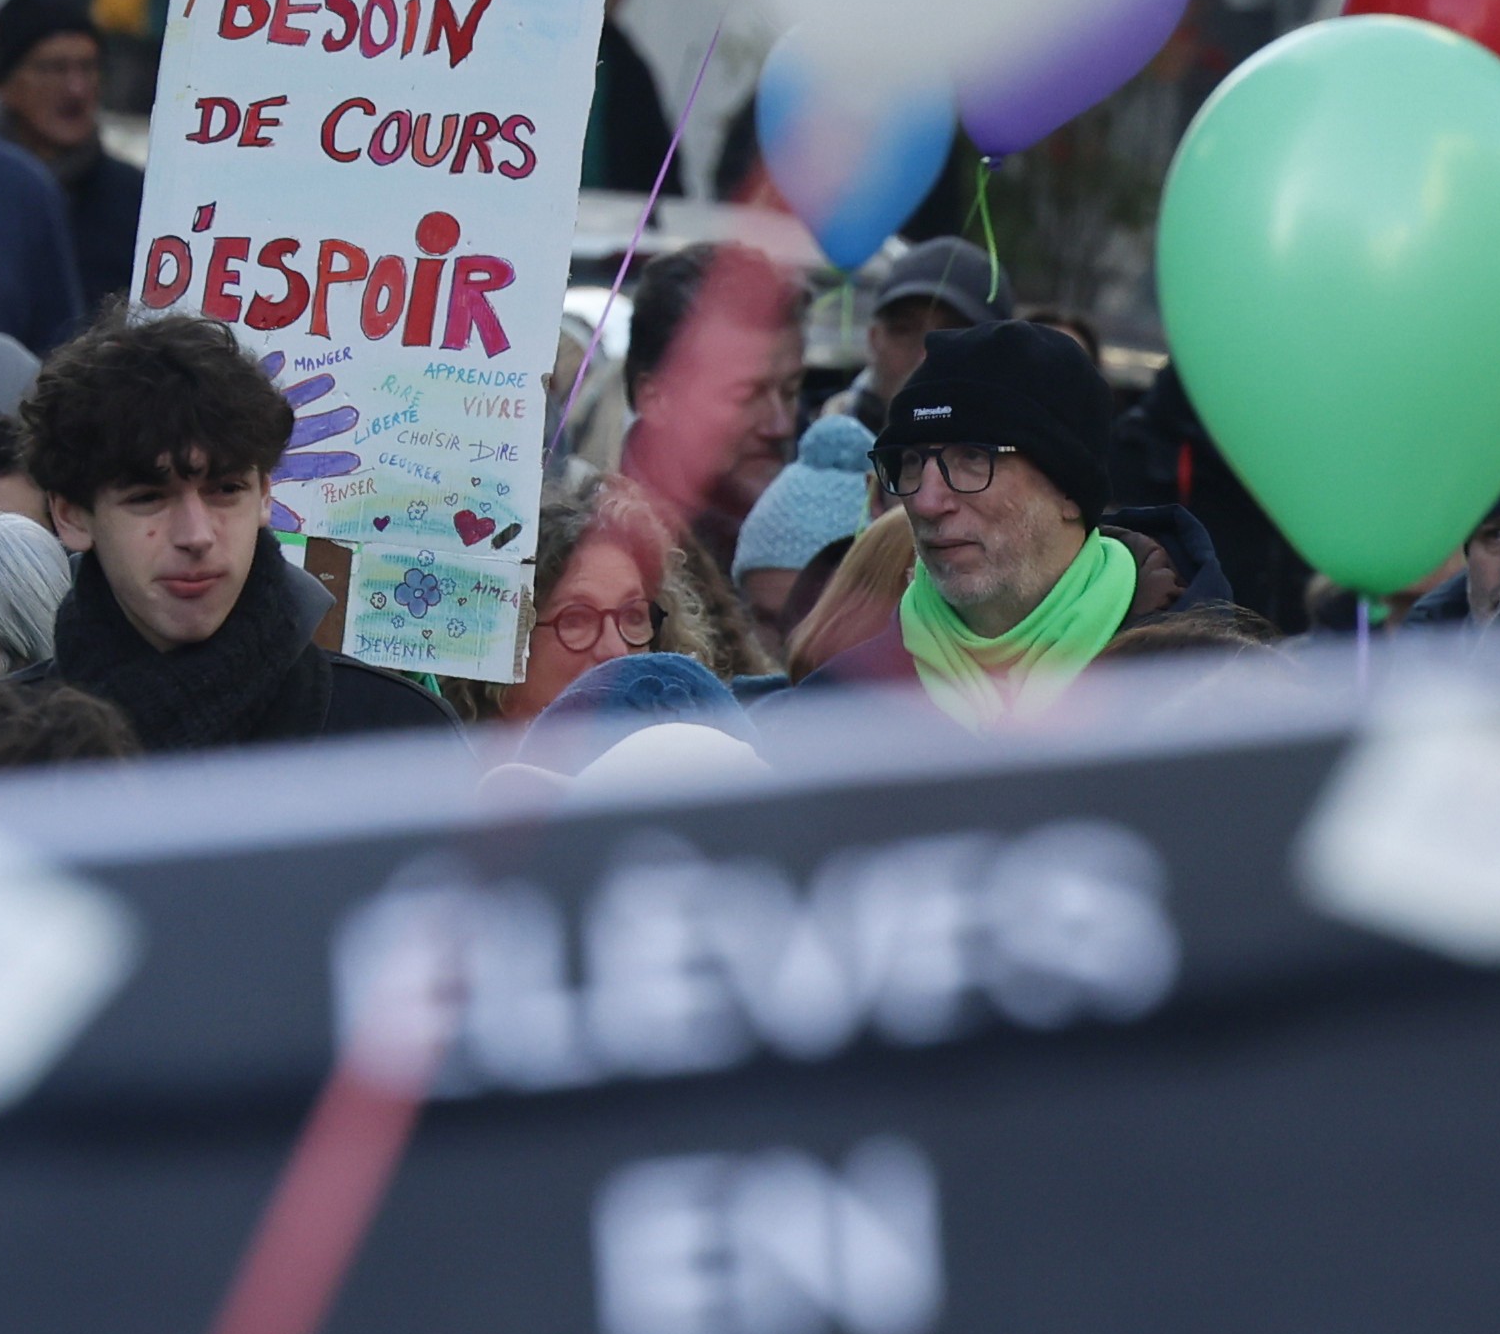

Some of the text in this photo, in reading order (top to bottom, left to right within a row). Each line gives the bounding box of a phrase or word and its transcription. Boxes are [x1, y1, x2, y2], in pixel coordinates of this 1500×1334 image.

[186, 95, 537, 180] DE COURS
[140, 201, 516, 359] D'ESPOIR
[293, 346, 353, 372] MANGER
[423, 362, 528, 389] APPRENDRE
[463, 393, 526, 418] VIVRE
[397, 429, 460, 451] CHOISIR
[469, 440, 519, 462] DIRE
[321, 478, 377, 504] PENSER
[353, 634, 435, 660] DEVENIR
